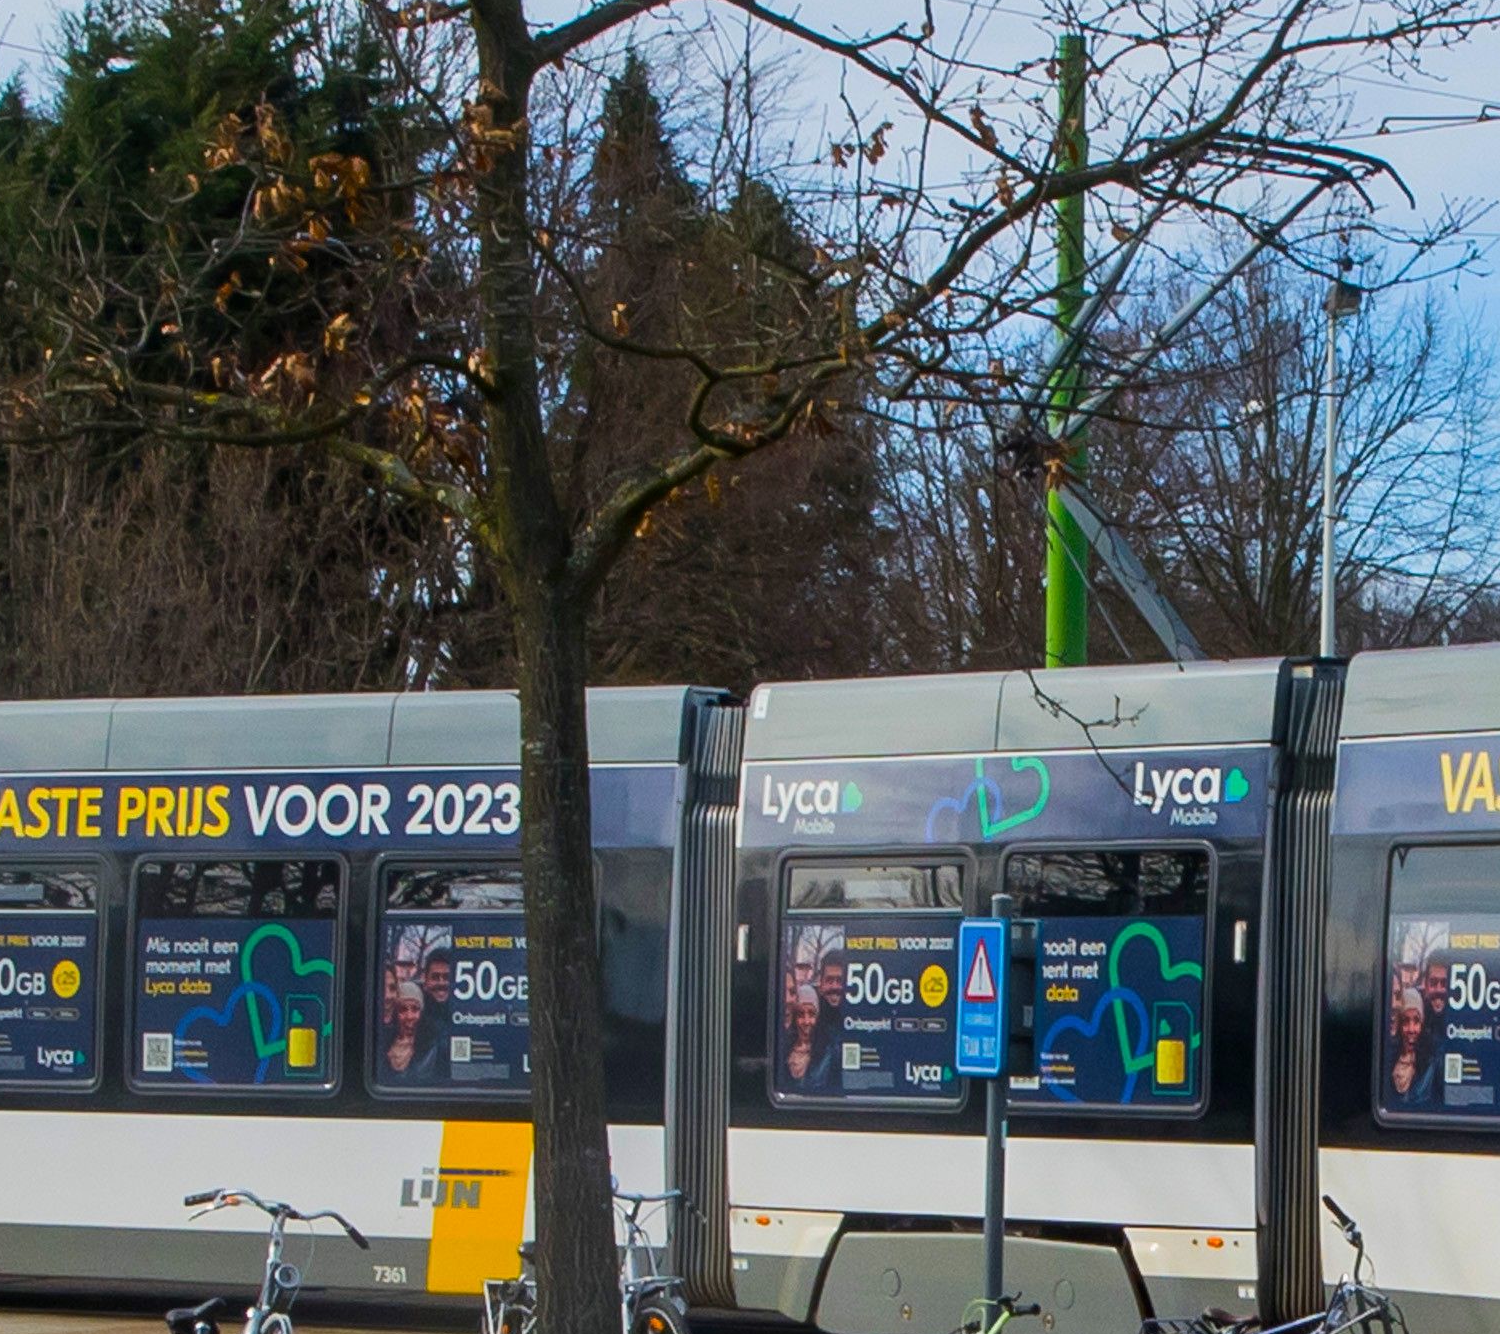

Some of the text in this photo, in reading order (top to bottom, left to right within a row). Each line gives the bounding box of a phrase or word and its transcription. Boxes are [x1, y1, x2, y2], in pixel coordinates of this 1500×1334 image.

[1134, 762, 1221, 814] Lyca
[762, 774, 839, 823] Lyca
[117, 785, 231, 837] PRIJS
[243, 783, 391, 836] VOOR
[1170, 807, 1218, 826] Mobile
[146, 937, 239, 954] Mis nooit een
[1080, 942, 1106, 956] een
[145, 959, 231, 974] moment met
[1072, 961, 1099, 979] met
[145, 977, 212, 997] Lyca data
[845, 962, 914, 1005] 50GB
[1046, 984, 1079, 1001] data
[37, 1046, 74, 1068] Lyca
[905, 1061, 941, 1085] Lyca
[372, 1266, 407, 1283] 7361
